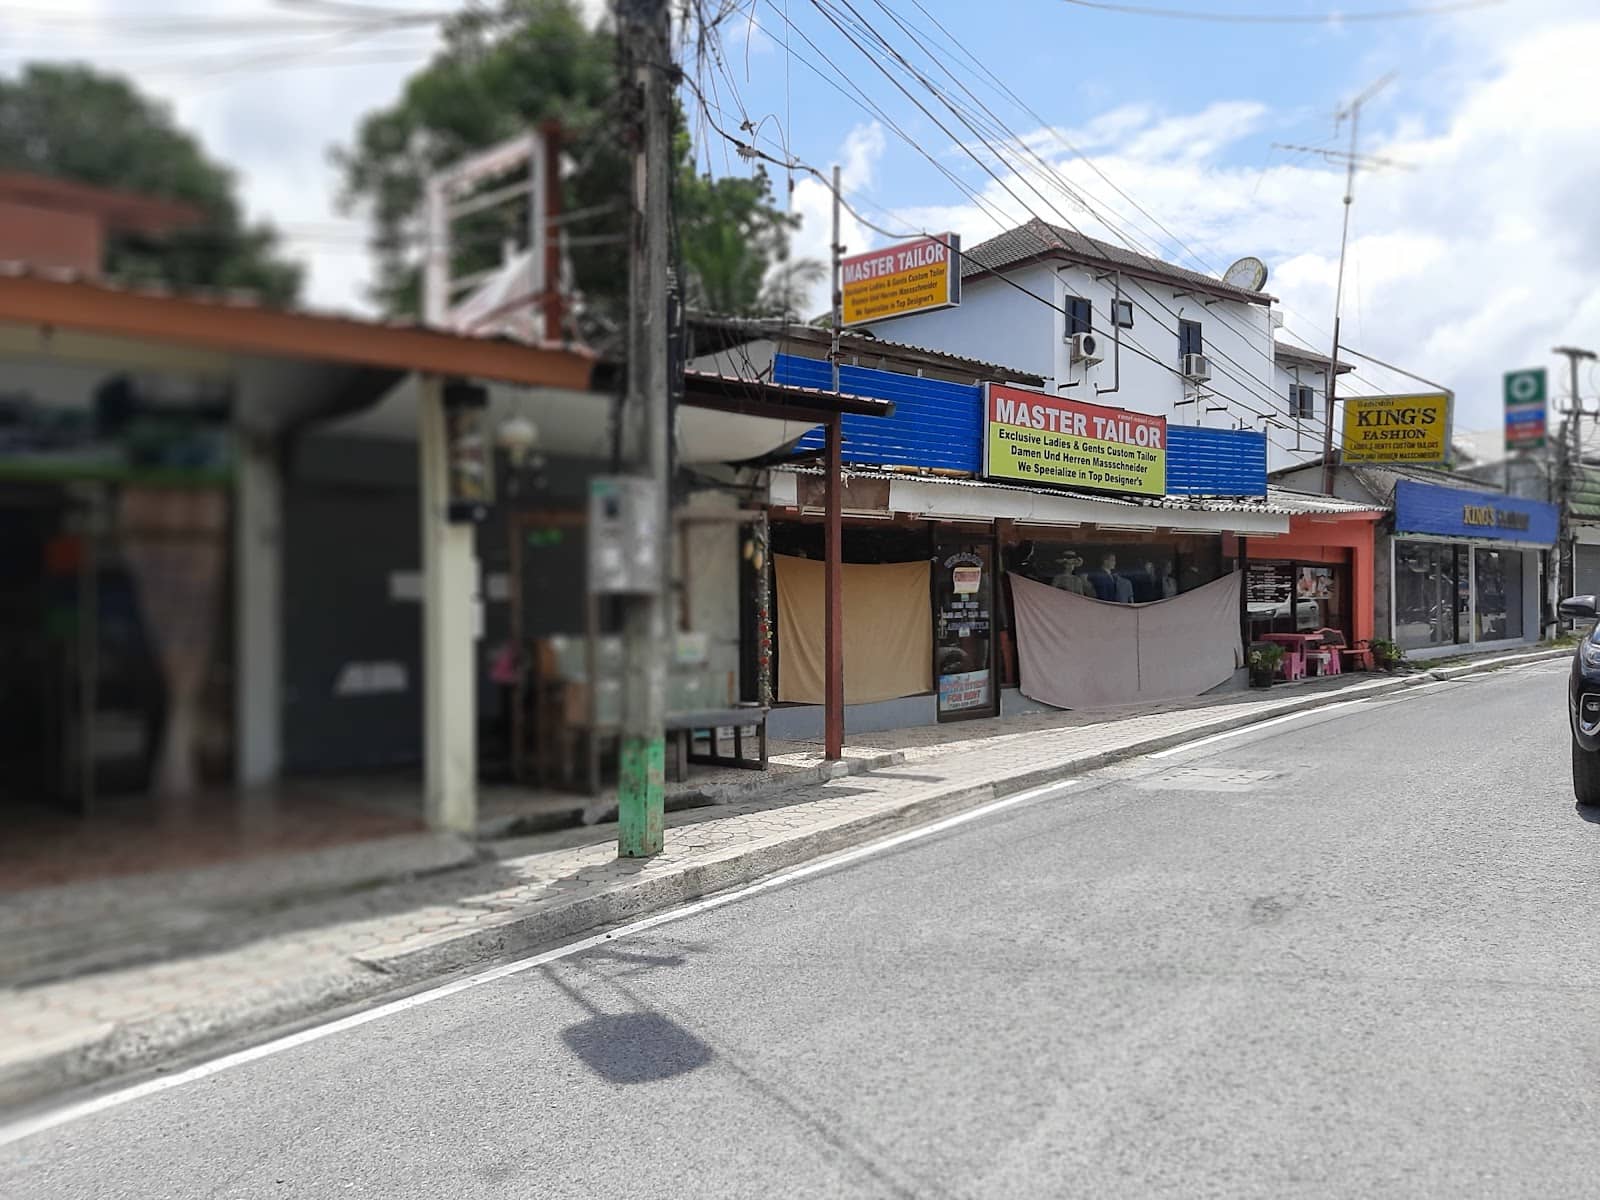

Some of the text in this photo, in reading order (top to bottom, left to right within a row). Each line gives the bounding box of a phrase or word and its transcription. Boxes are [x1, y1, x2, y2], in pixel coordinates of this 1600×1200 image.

[844, 243, 945, 283] MASTER TAILOR
[996, 398, 1162, 449] MASTER TAILOR
[1354, 407, 1437, 427] KING'S
[999, 428, 1157, 463] Exclusive Ladies & Gents Custom Tailor
[1363, 428, 1426, 440] FASHION
[1011, 445, 1148, 474] Damen Und Herren Massschneider
[1017, 461, 1032, 473] We
[1078, 469, 1086, 480] in
[1088, 470, 1103, 484] Top
[1104, 472, 1143, 487] Designer's
